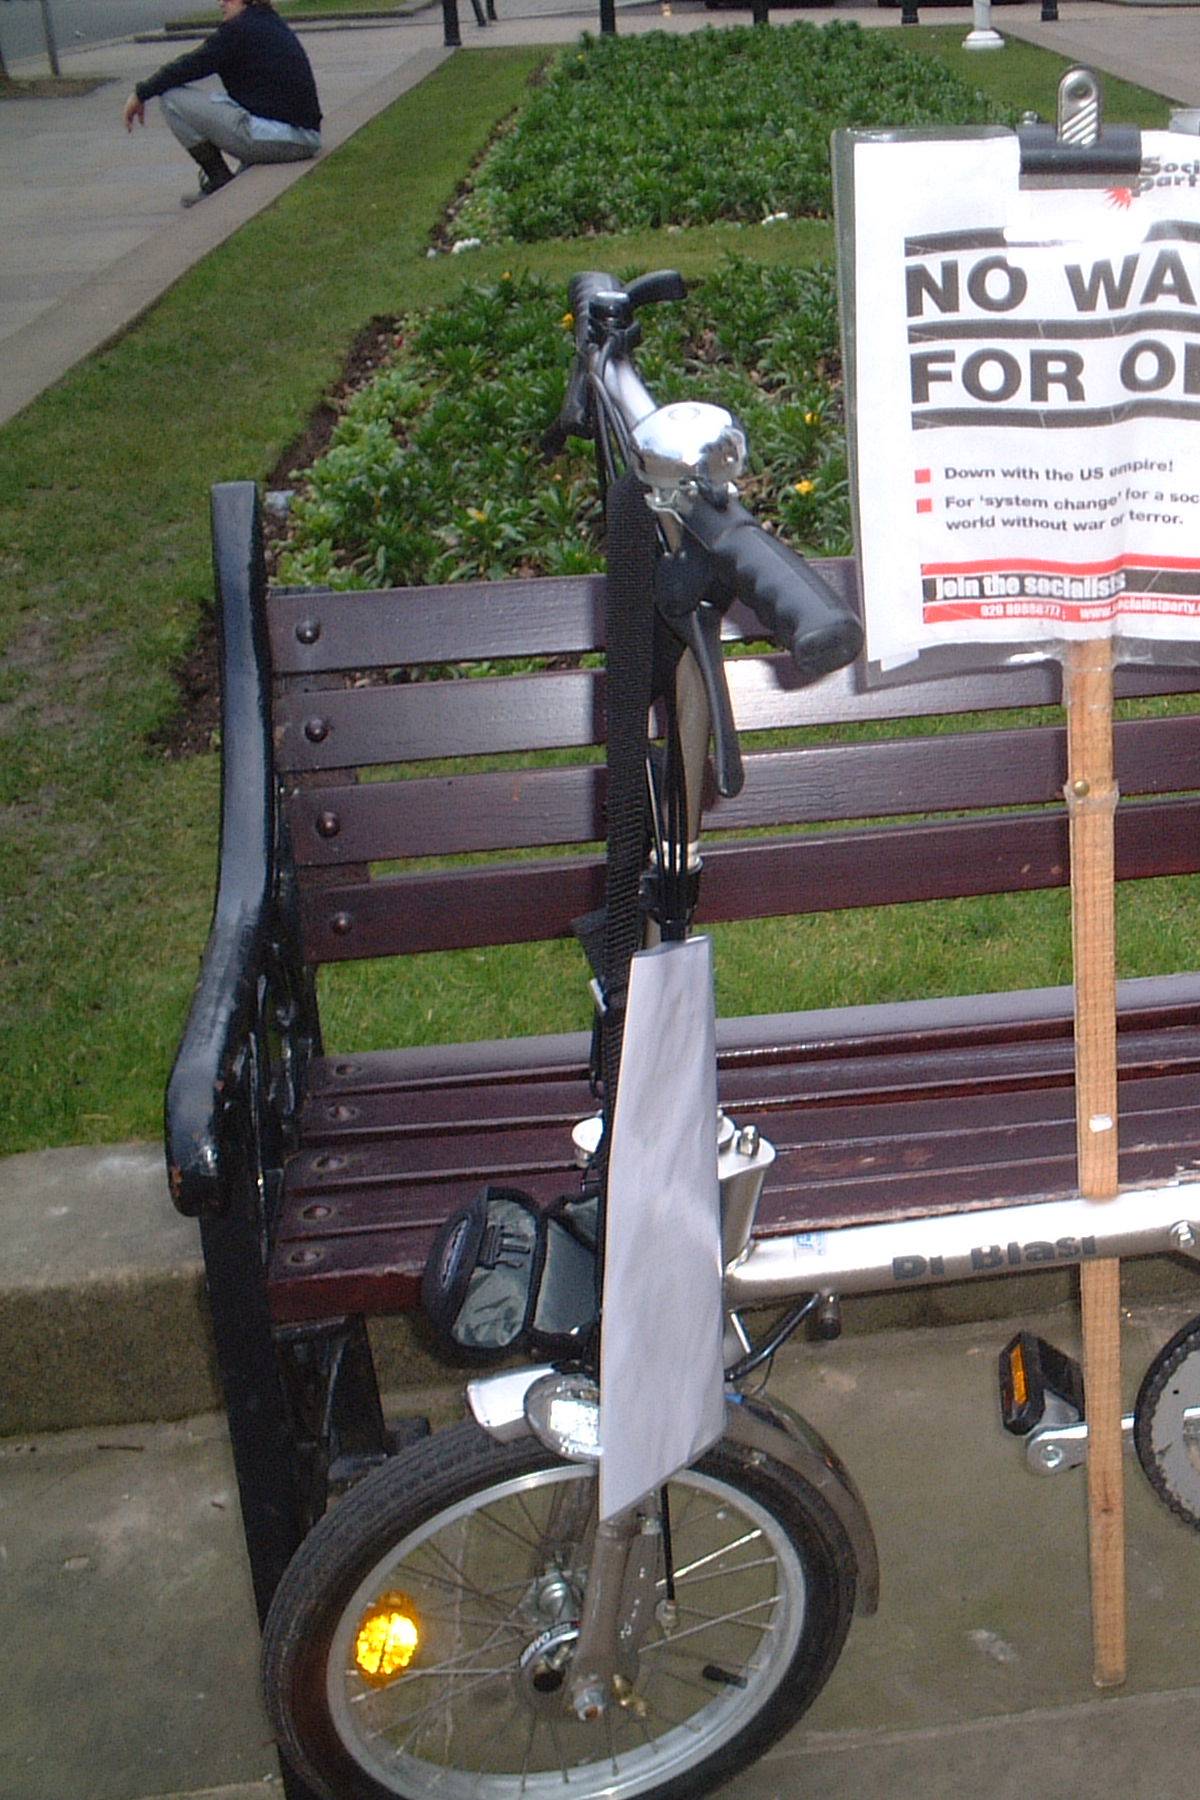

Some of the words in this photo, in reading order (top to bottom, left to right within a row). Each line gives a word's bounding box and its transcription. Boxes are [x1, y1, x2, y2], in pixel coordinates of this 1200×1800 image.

[905, 255, 1028, 317] NO
[910, 347, 1086, 403] FOR
[944, 466, 996, 480] Down
[1001, 466, 1040, 480] with
[1045, 467, 1074, 481] the
[1080, 466, 1104, 481] US
[1109, 458, 1174, 477] empire!
[945, 495, 974, 509] For
[980, 493, 1049, 509] 'system
[1053, 490, 1122, 511] change'
[1125, 487, 1149, 500] for
[1154, 491, 1164, 501] a
[946, 515, 996, 530] world
[1001, 515, 1069, 531] without
[1073, 518, 1106, 531] war
[1110, 513, 1125, 527] or
[1129, 509, 1184, 525] terror.
[983, 574, 1021, 597] the
[1024, 572, 1127, 600] socialists
[893, 1254, 945, 1280] Di
